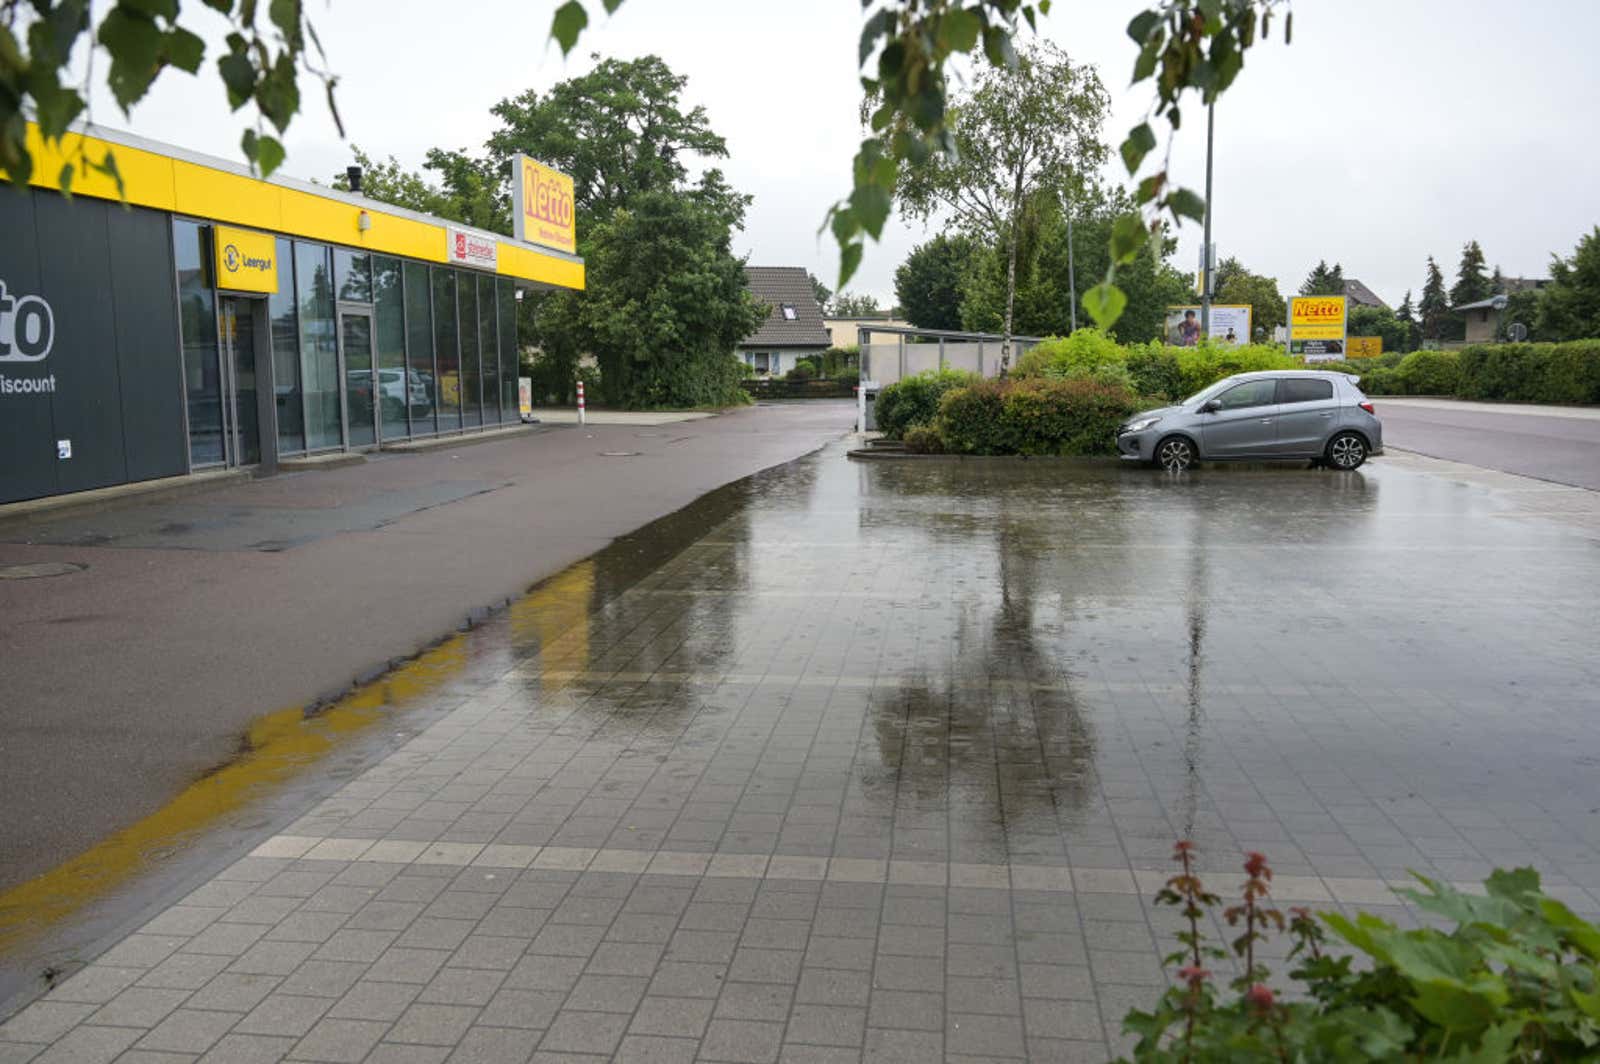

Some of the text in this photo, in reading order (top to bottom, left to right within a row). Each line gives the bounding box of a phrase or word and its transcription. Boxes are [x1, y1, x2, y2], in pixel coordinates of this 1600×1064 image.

[525, 165, 573, 228] Netto
[242, 253, 272, 272] Leergut
[1293, 300, 1341, 317] Netto
